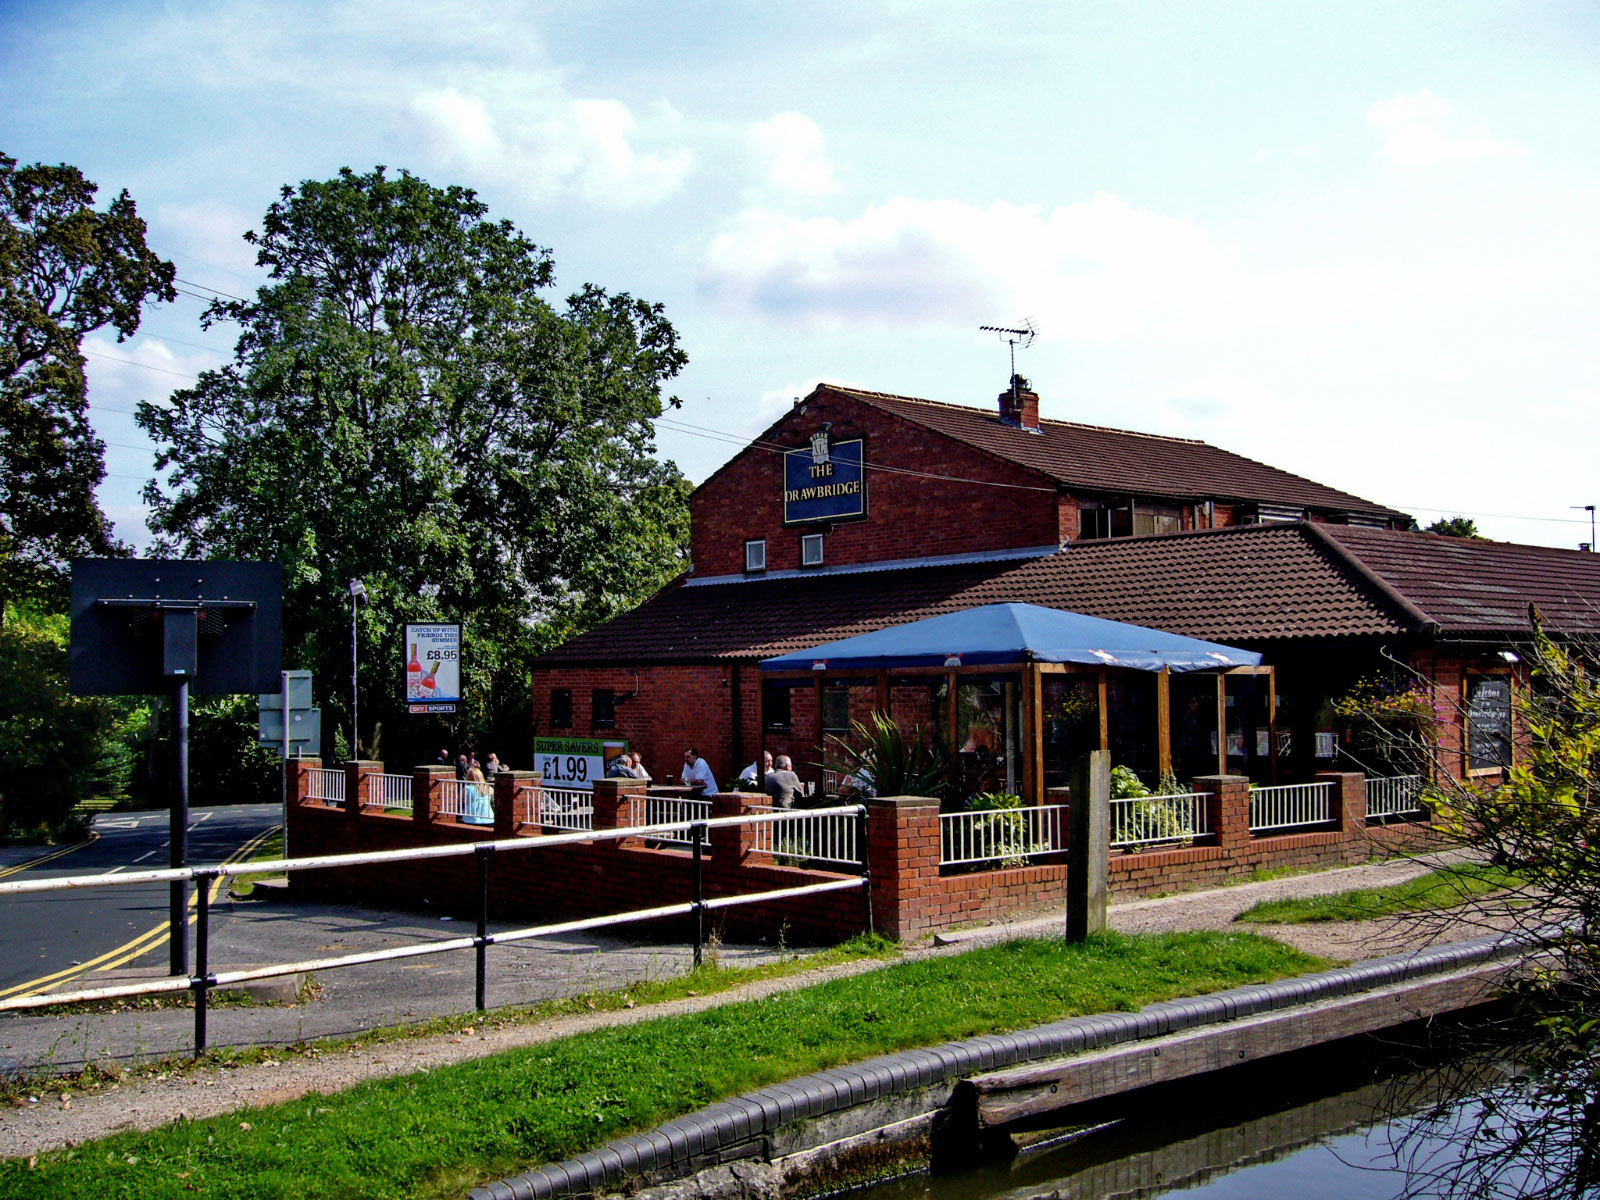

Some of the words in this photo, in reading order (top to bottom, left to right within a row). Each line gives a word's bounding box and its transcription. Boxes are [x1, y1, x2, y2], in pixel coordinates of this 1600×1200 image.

[809, 464, 833, 478] THE
[785, 481, 860, 502] DRAWBRIDGE
[427, 650, 458, 660] £8.95
[536, 740, 563, 753] SUPER
[565, 741, 600, 754] SAVERS
[543, 756, 587, 782] £1.99
